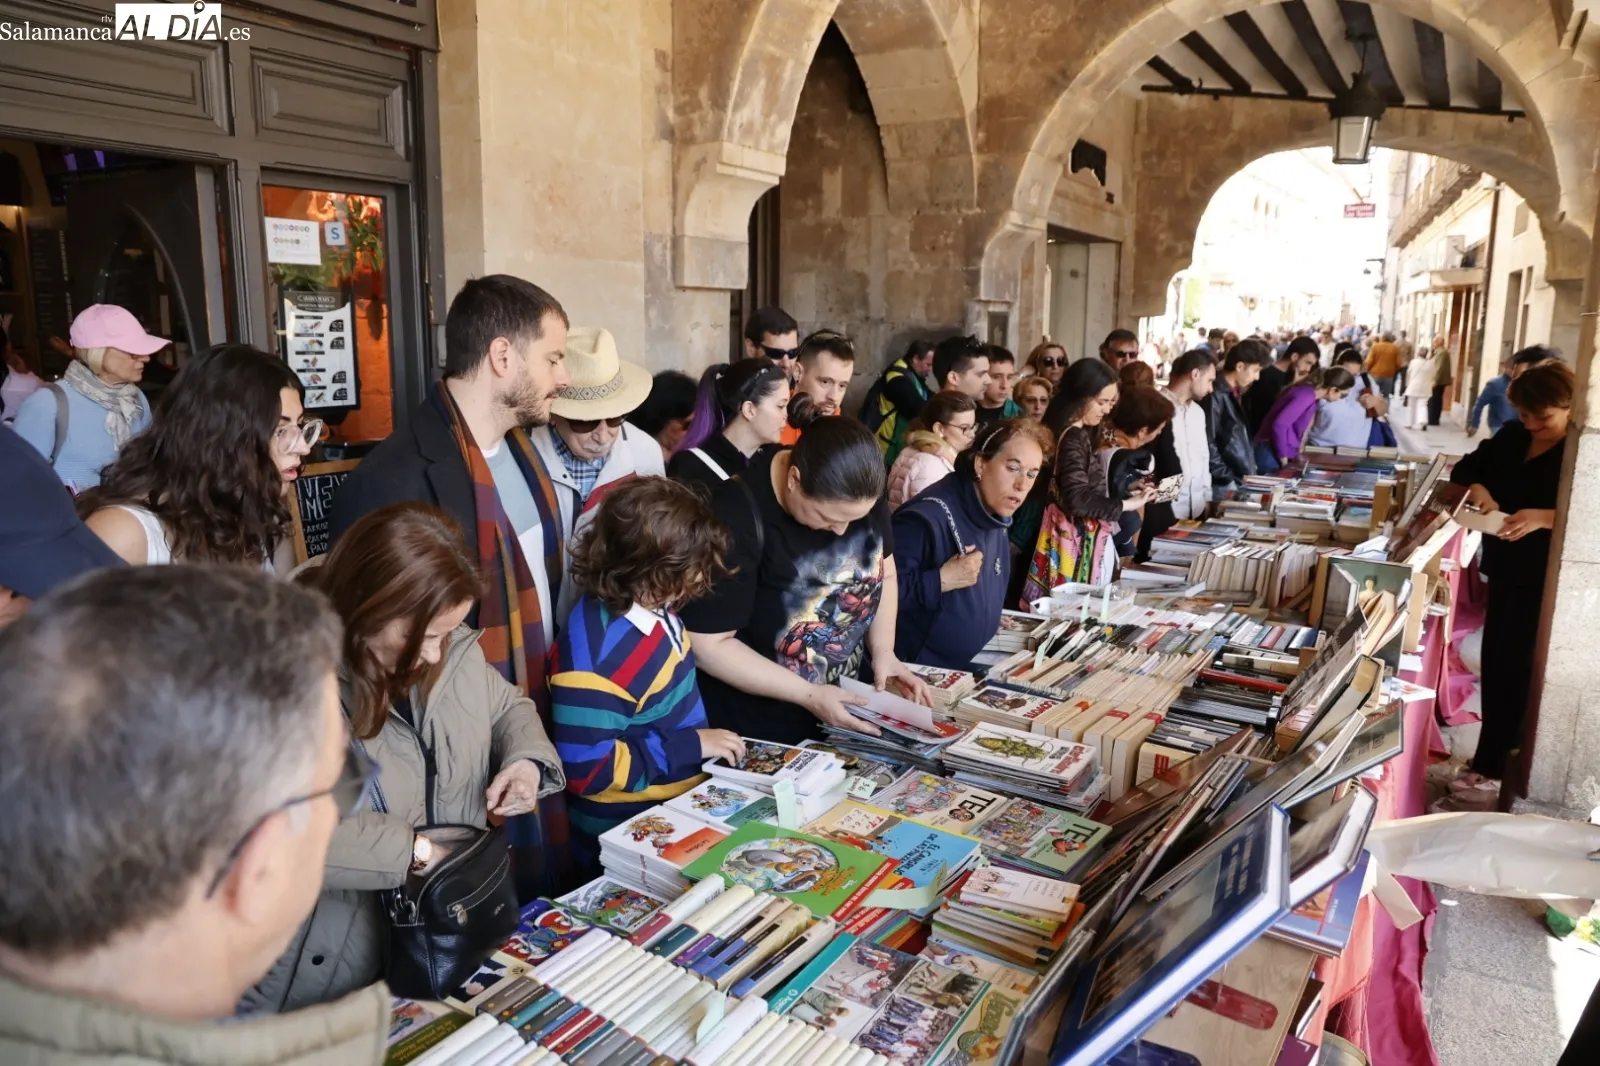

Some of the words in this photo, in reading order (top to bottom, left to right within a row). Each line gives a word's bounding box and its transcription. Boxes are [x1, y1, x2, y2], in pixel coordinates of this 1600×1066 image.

[331, 226, 340, 240] S
[927, 833, 939, 841] DE
[917, 840, 930, 850] LAS
[927, 843, 940, 851] EL
[893, 850, 931, 876] CANGREJO
